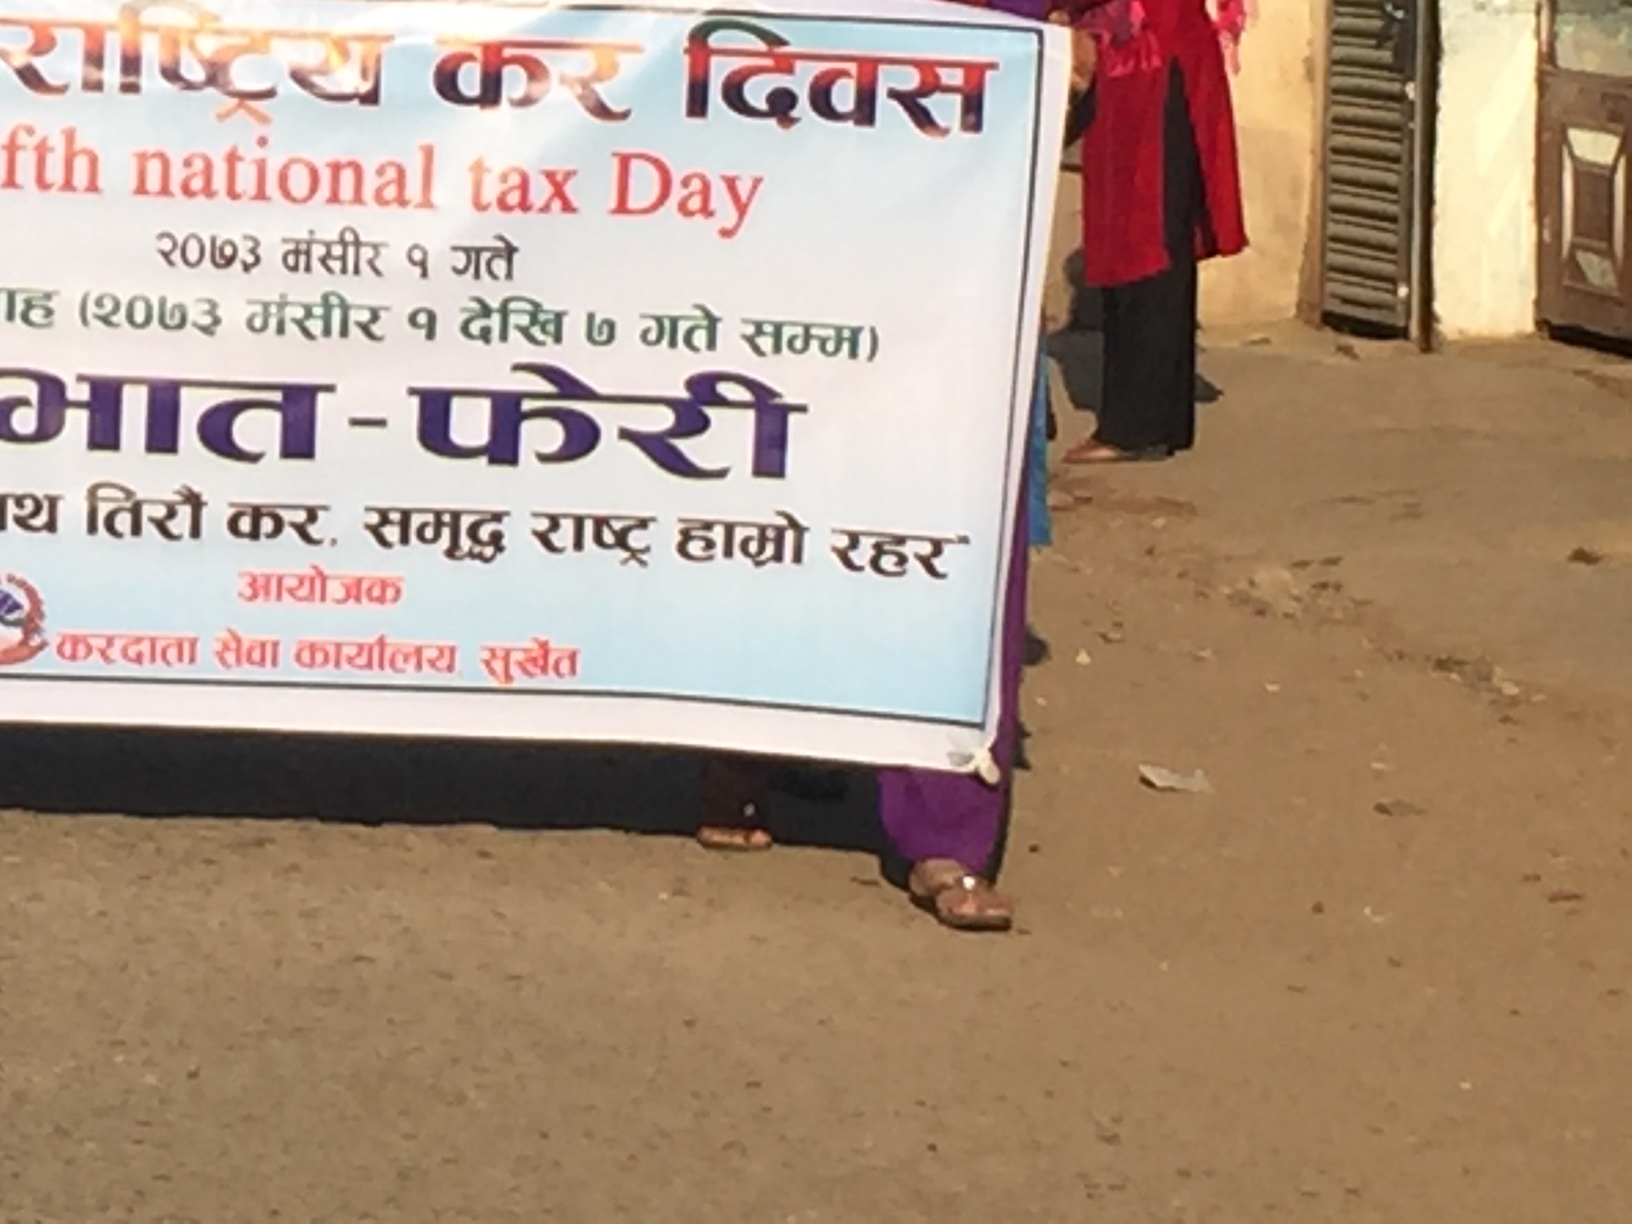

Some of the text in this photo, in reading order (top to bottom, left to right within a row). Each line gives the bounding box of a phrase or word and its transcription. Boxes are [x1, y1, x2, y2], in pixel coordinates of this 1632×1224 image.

[432, 34, 645, 122] कर
[684, 17, 1000, 138] दिवस
[131, 137, 438, 212] national
[469, 154, 580, 214] tax
[607, 151, 764, 238] Day
[155, 226, 520, 280] २०७३ मंसीर १ गते
[79, 290, 223, 338] (२०७३
[246, 290, 391, 342] मंसीर
[407, 306, 437, 342] १
[459, 295, 570, 346] देखि
[585, 308, 618, 347] ७
[639, 304, 724, 351] गते
[740, 315, 880, 362] सम्म)
[531, 510, 657, 567] राष्ट्र
[676, 510, 810, 567] हाम्रो
[237, 565, 405, 605] आयोजक
[55, 627, 581, 686] करदाता सेवा कार्यालय सुर्खेत
